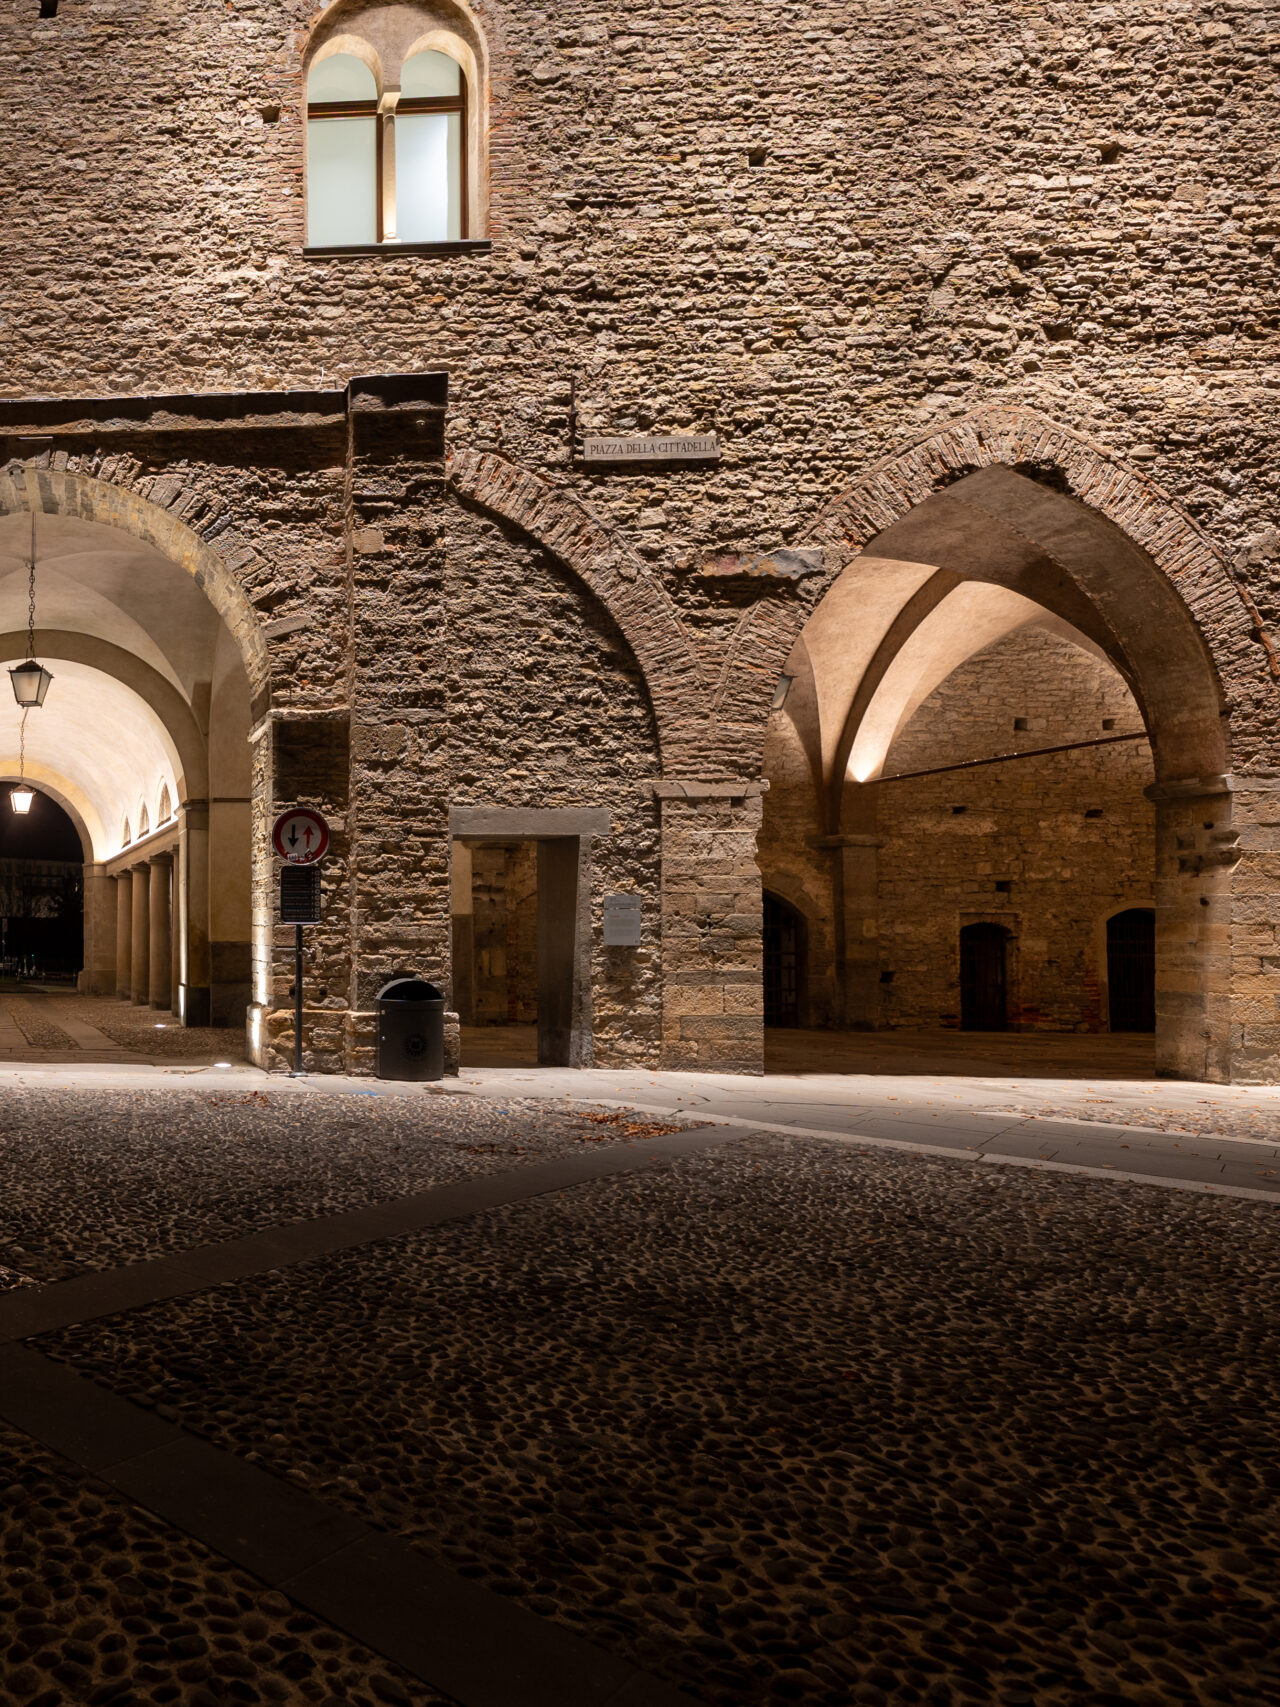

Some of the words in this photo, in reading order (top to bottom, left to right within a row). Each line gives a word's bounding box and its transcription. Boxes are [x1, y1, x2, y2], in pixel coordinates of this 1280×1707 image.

[590, 444, 623, 455] PIAZZA
[626, 443, 656, 454] DELLA
[658, 441, 716, 453] CITTADELLA
